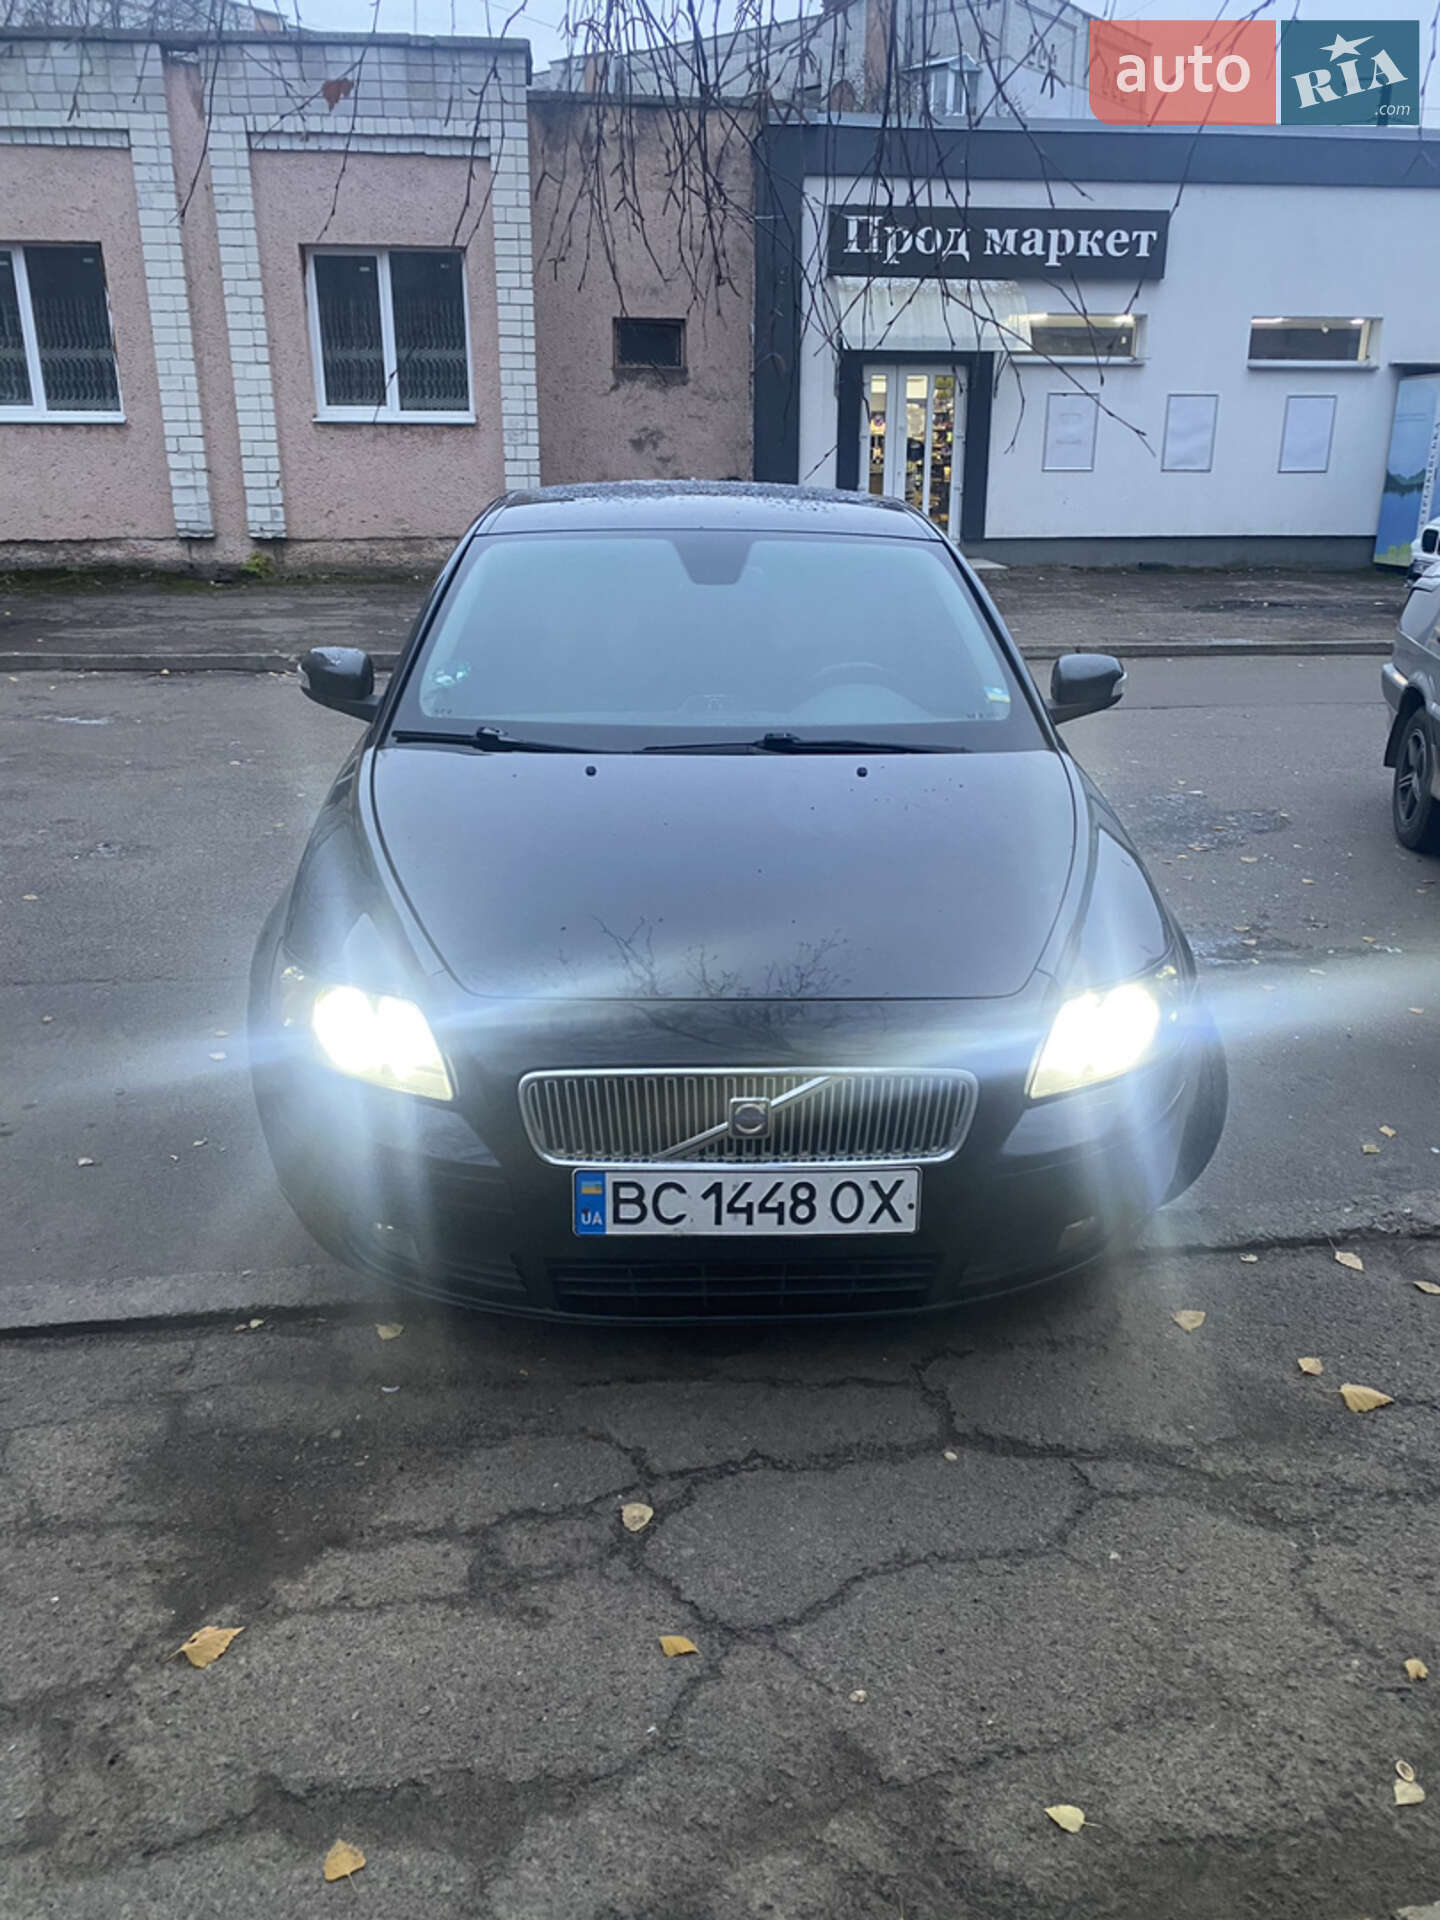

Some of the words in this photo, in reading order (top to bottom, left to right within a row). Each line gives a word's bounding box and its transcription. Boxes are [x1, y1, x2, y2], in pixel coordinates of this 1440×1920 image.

[843, 215, 971, 264] Прод
[984, 227, 1157, 267] маркет
[581, 1210, 603, 1226] UA
[612, 1181, 687, 1225] BC
[701, 1181, 817, 1225] 1448
[830, 1179, 904, 1224] OX
